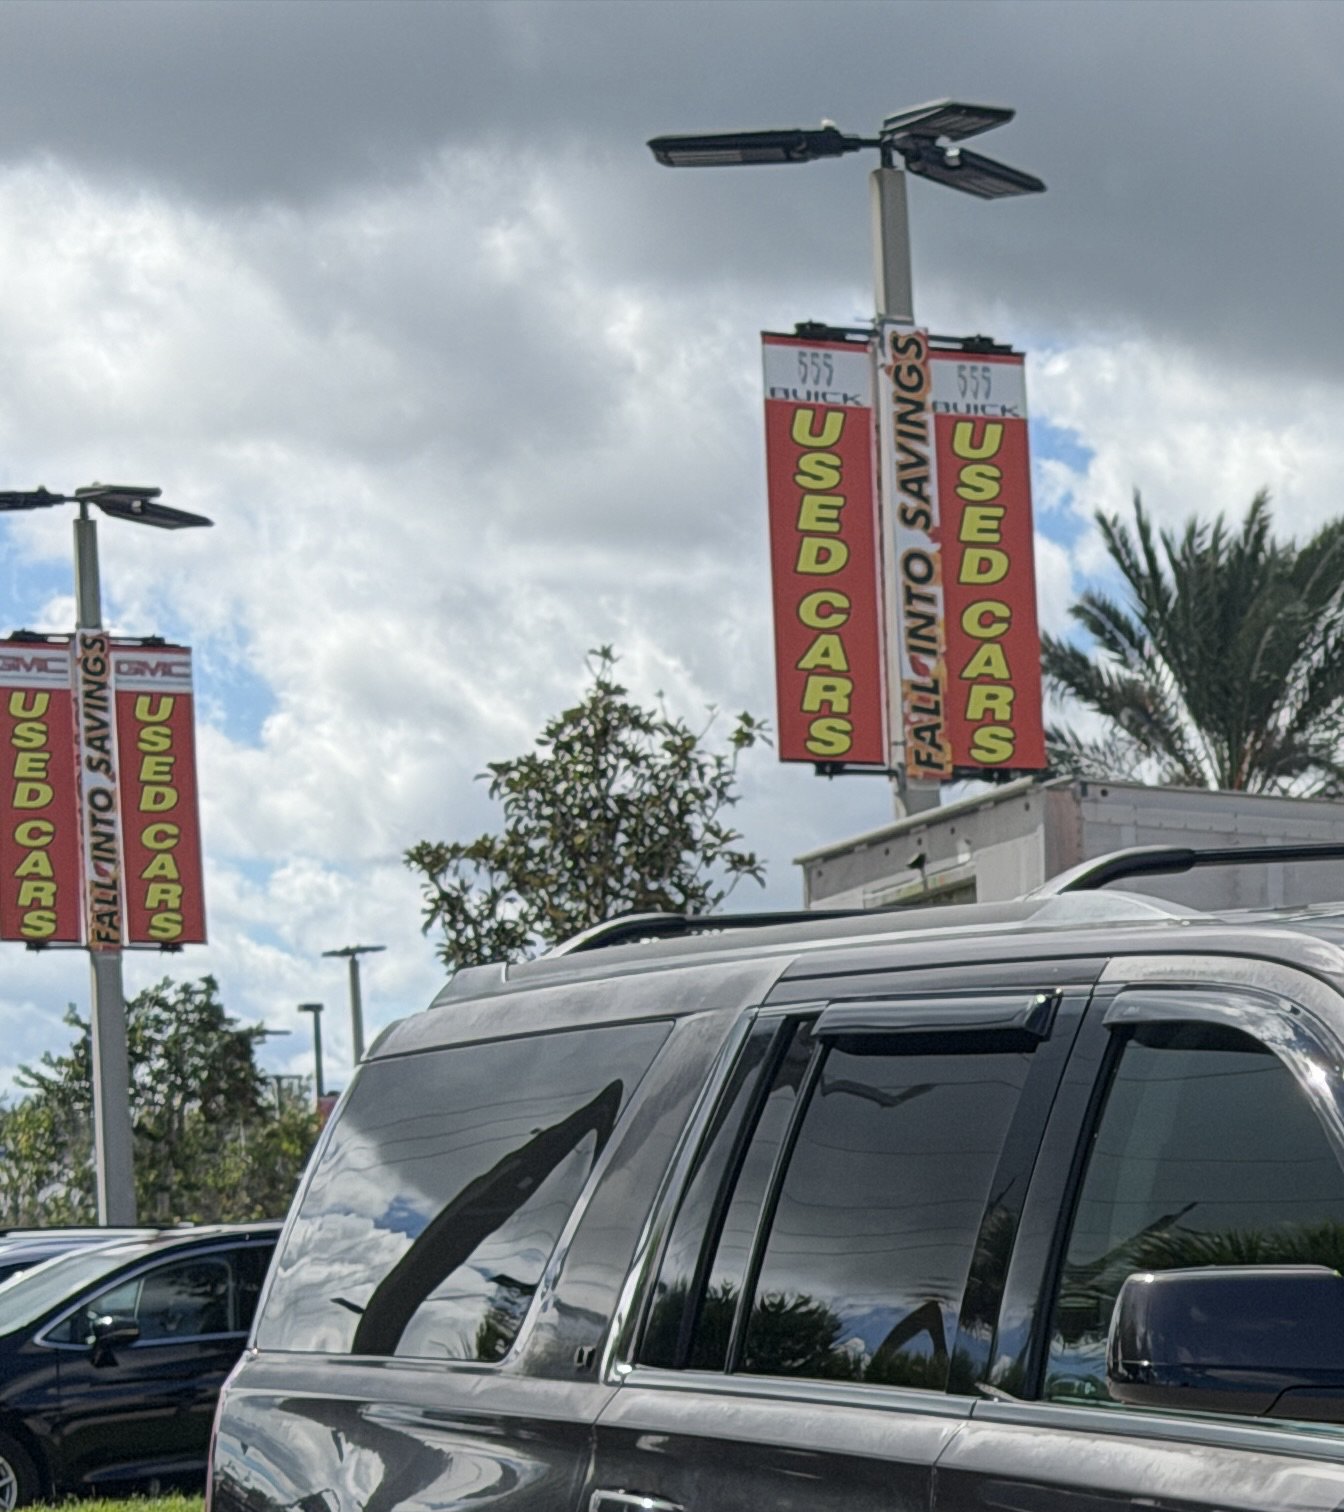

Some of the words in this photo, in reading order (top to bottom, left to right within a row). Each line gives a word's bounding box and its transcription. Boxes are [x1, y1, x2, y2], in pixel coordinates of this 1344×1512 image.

[791, 408, 850, 576] USED
[892, 333, 932, 533] SAVINGS
[952, 421, 1010, 586] USED
[902, 551, 938, 659] INTO
[80, 636, 111, 779] SAVINGS
[115, 659, 192, 678] GMC
[796, 589, 855, 757] CARS
[912, 674, 945, 772] FALL
[959, 600, 1015, 765] CARS
[8, 690, 54, 810] USED
[134, 694, 179, 813] USED
[13, 818, 58, 940] CARS
[88, 788, 116, 866] INTO
[139, 821, 184, 942] CARS
[95, 877, 120, 945] FALL
